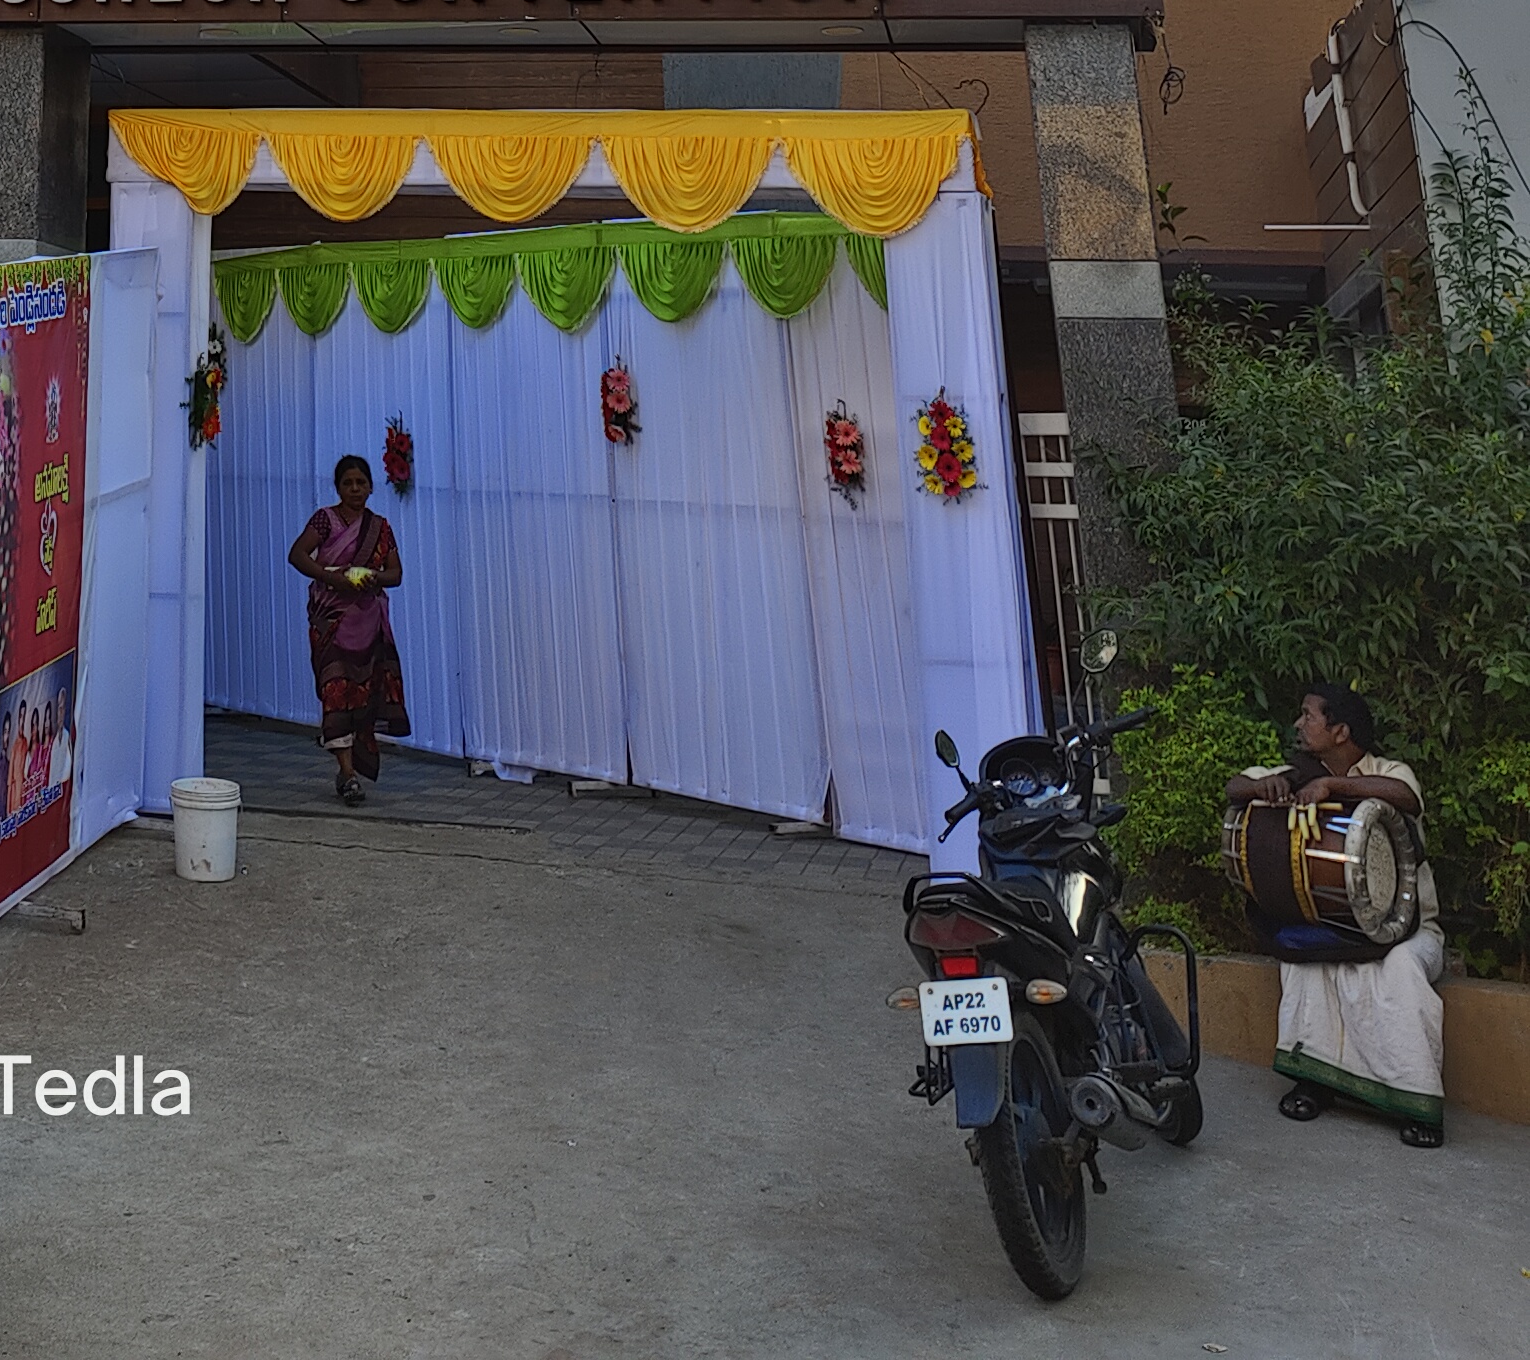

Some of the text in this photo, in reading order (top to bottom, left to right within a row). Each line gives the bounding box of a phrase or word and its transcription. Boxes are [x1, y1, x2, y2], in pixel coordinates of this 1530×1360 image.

[942, 992, 985, 1011] AP22
[933, 1015, 1001, 1037] AF 6970
